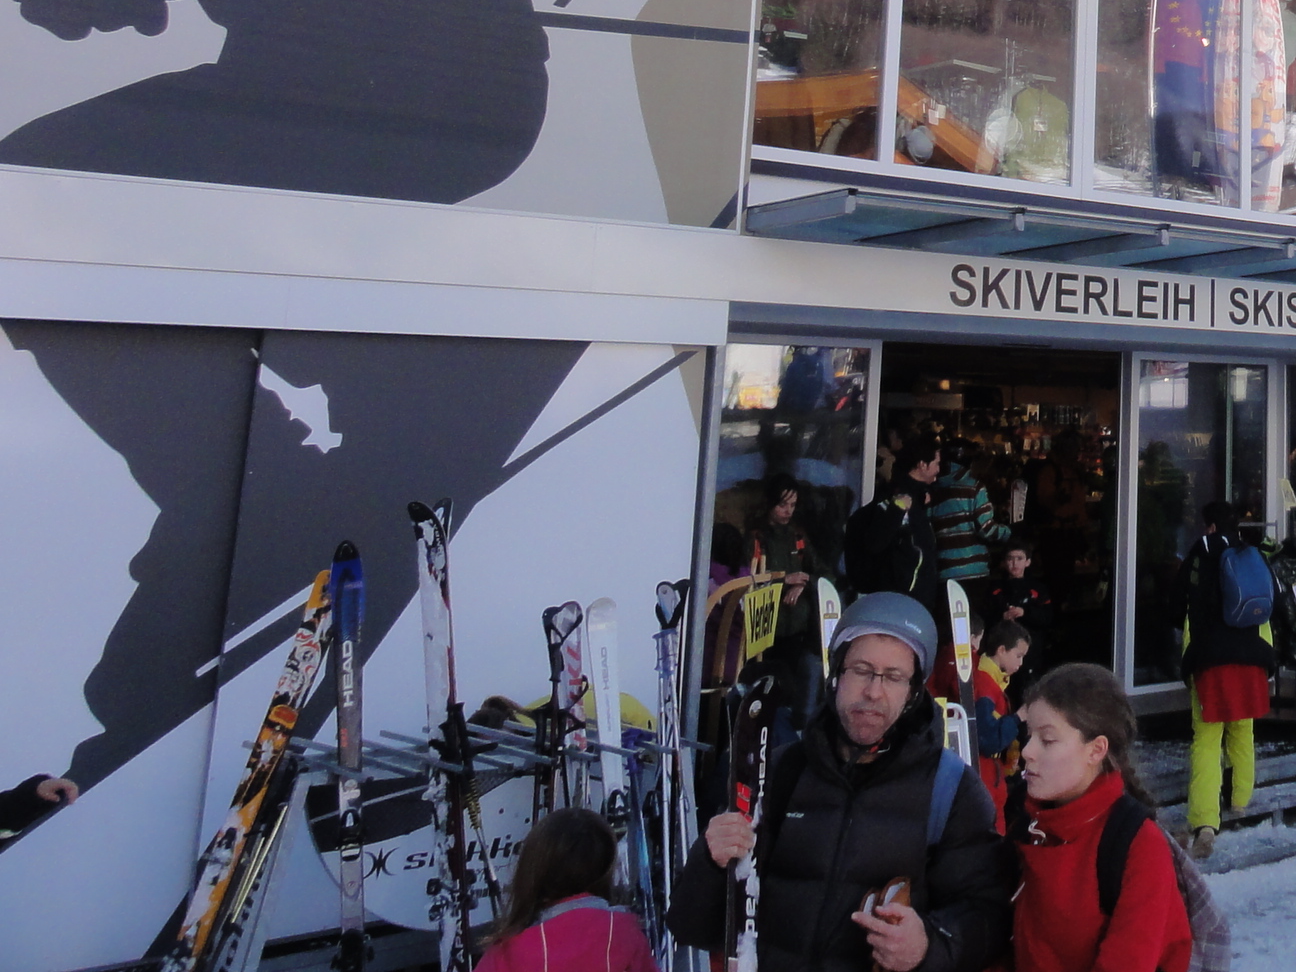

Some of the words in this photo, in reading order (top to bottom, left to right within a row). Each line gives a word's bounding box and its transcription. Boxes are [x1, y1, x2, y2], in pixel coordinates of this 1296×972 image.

[949, 262, 1196, 323] SKIVERLEIH
[342, 640, 354, 708] HEAD
[601, 646, 610, 691] HEAD
[758, 726, 768, 797] HEAD
